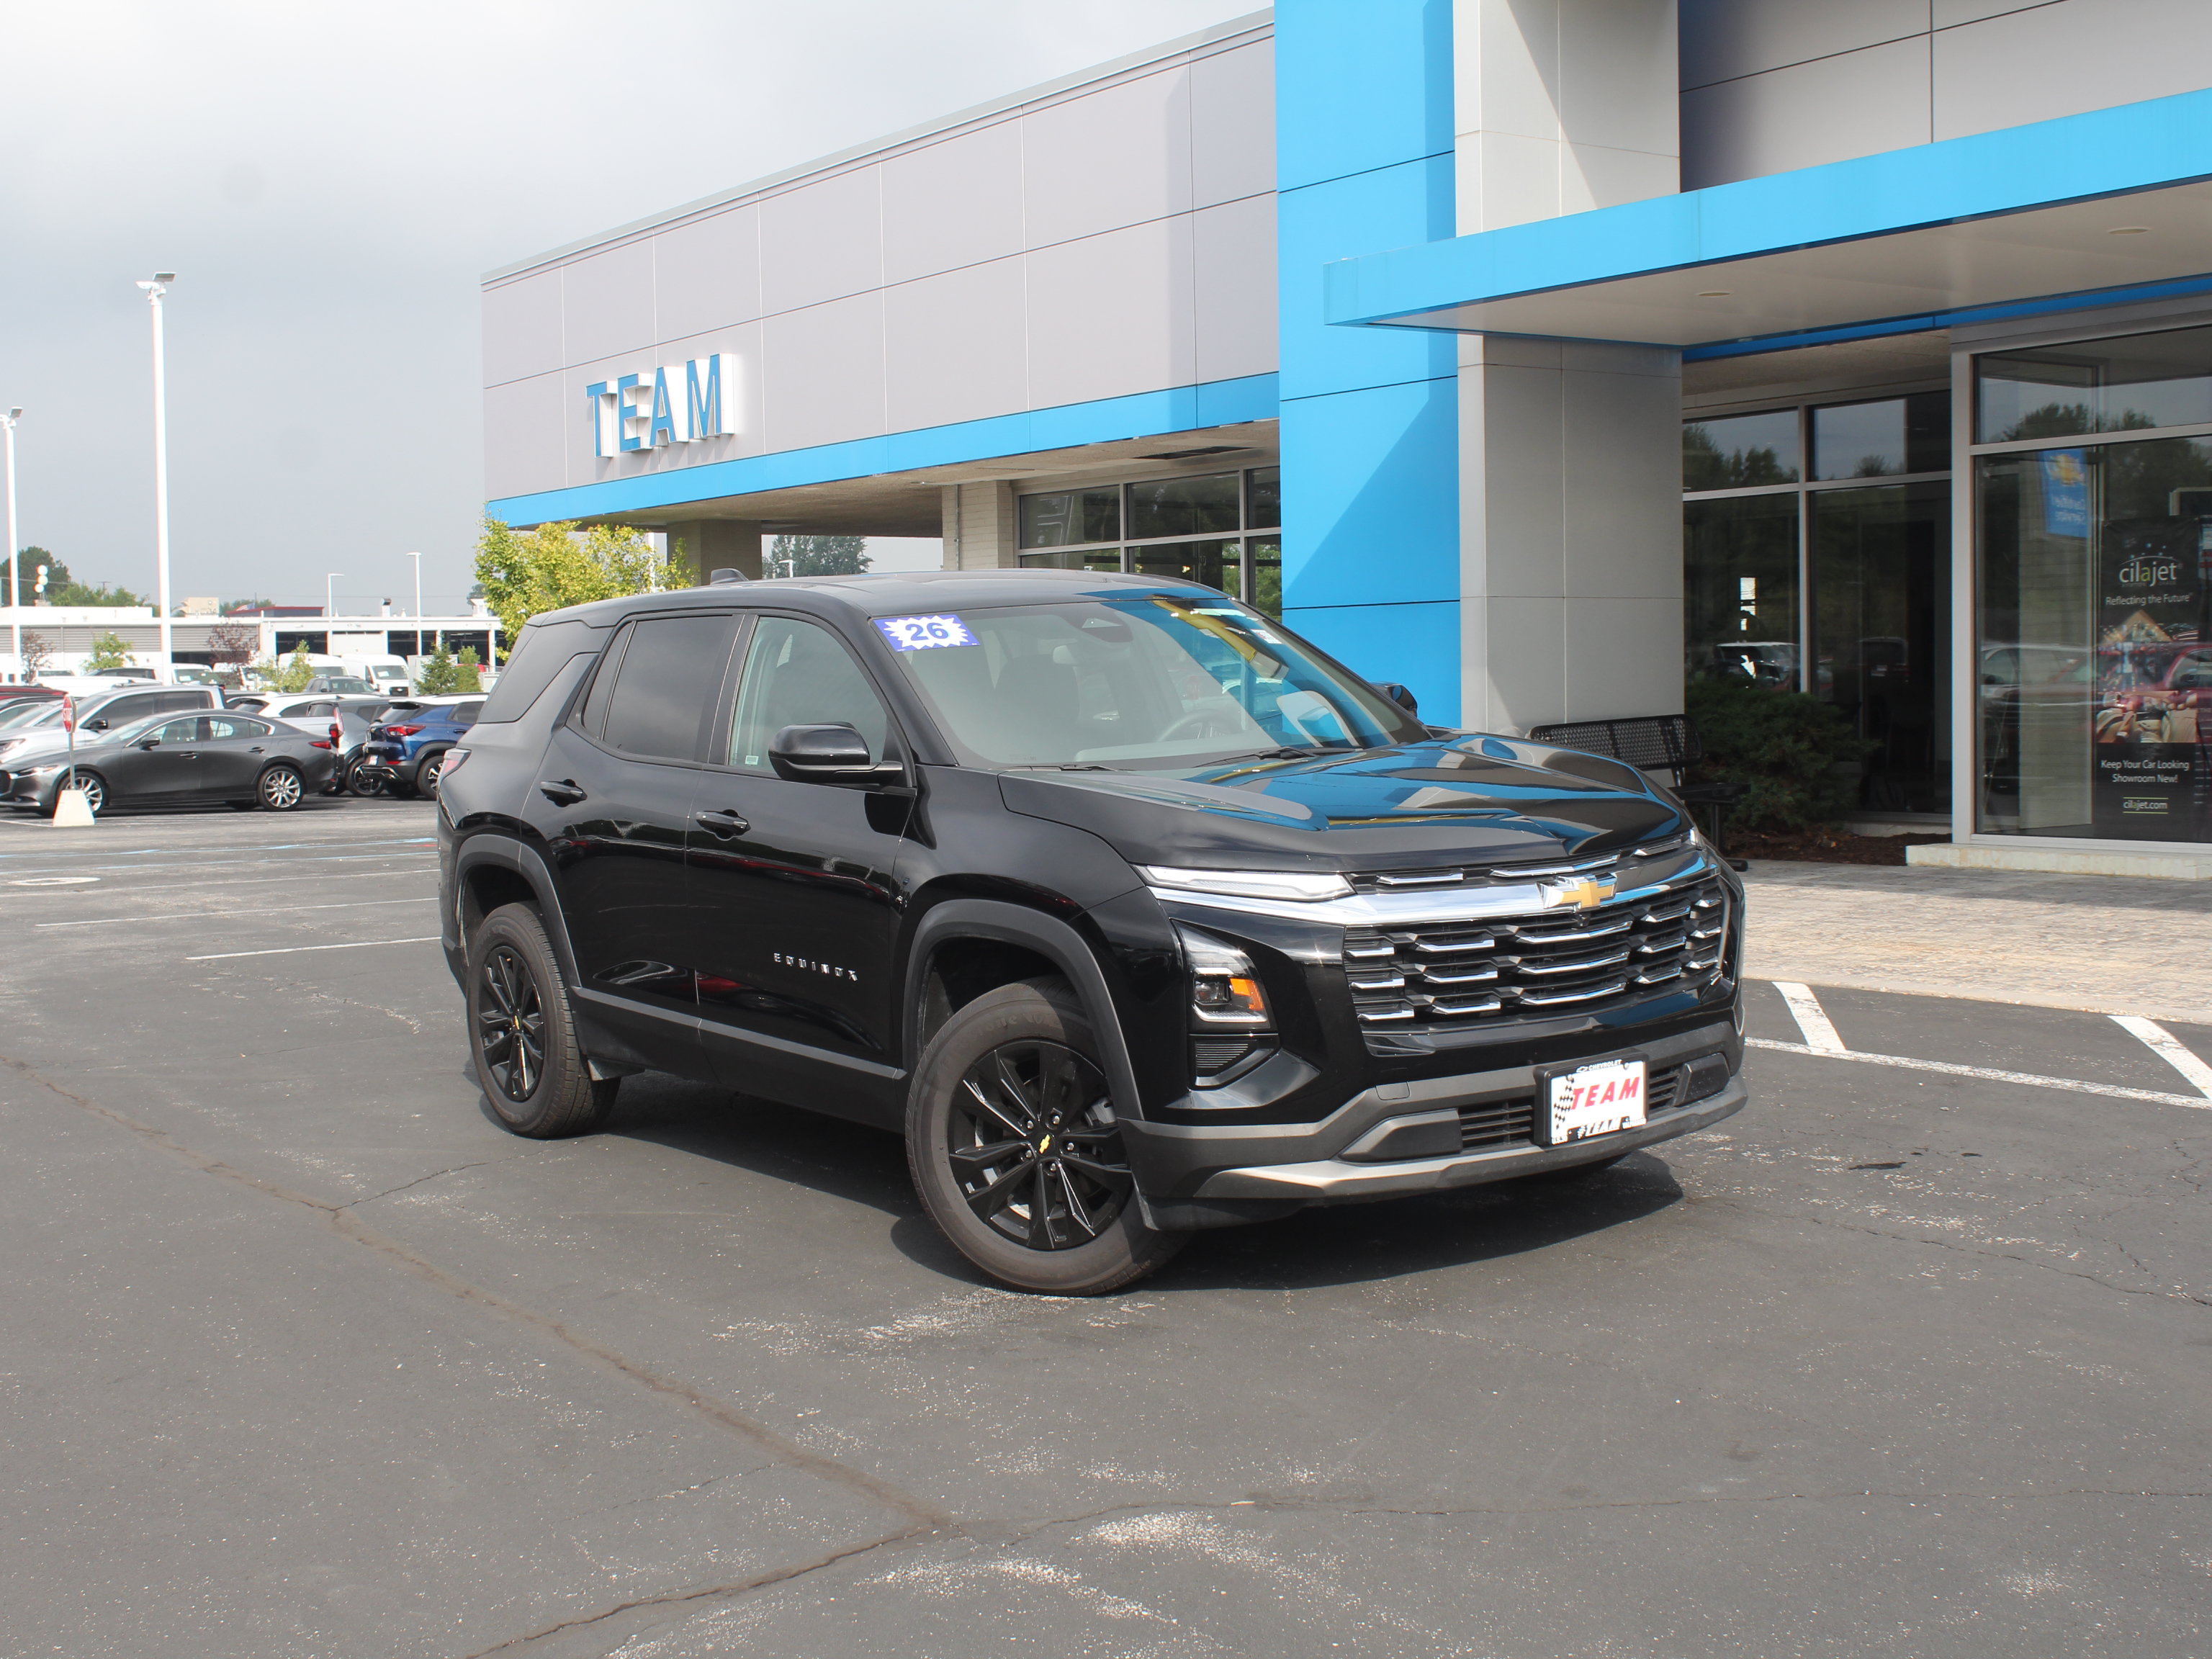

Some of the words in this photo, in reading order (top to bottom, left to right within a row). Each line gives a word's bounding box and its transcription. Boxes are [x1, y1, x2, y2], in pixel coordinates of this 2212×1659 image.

[585, 353, 734, 458] TEAM
[2119, 561, 2177, 587] cilajet
[2105, 595, 2146, 606] Reflecting
[2149, 594, 2162, 603] the
[2163, 594, 2190, 603] Future
[905, 622, 949, 642] 26
[2100, 760, 2121, 770] Keep
[2123, 760, 2141, 768] Your
[2142, 760, 2156, 769] Car
[2157, 760, 2190, 771] Looking
[2112, 773, 2156, 783] Showroom
[2157, 774, 2178, 783] New!
[2123, 800, 2167, 810] cilajet.com
[773, 953, 858, 981] EQUINOX
[1588, 1058, 1622, 1071] CHEVROLET
[1570, 1076, 1640, 1110] TEAM
[1586, 1118, 1622, 1136] TEAM
